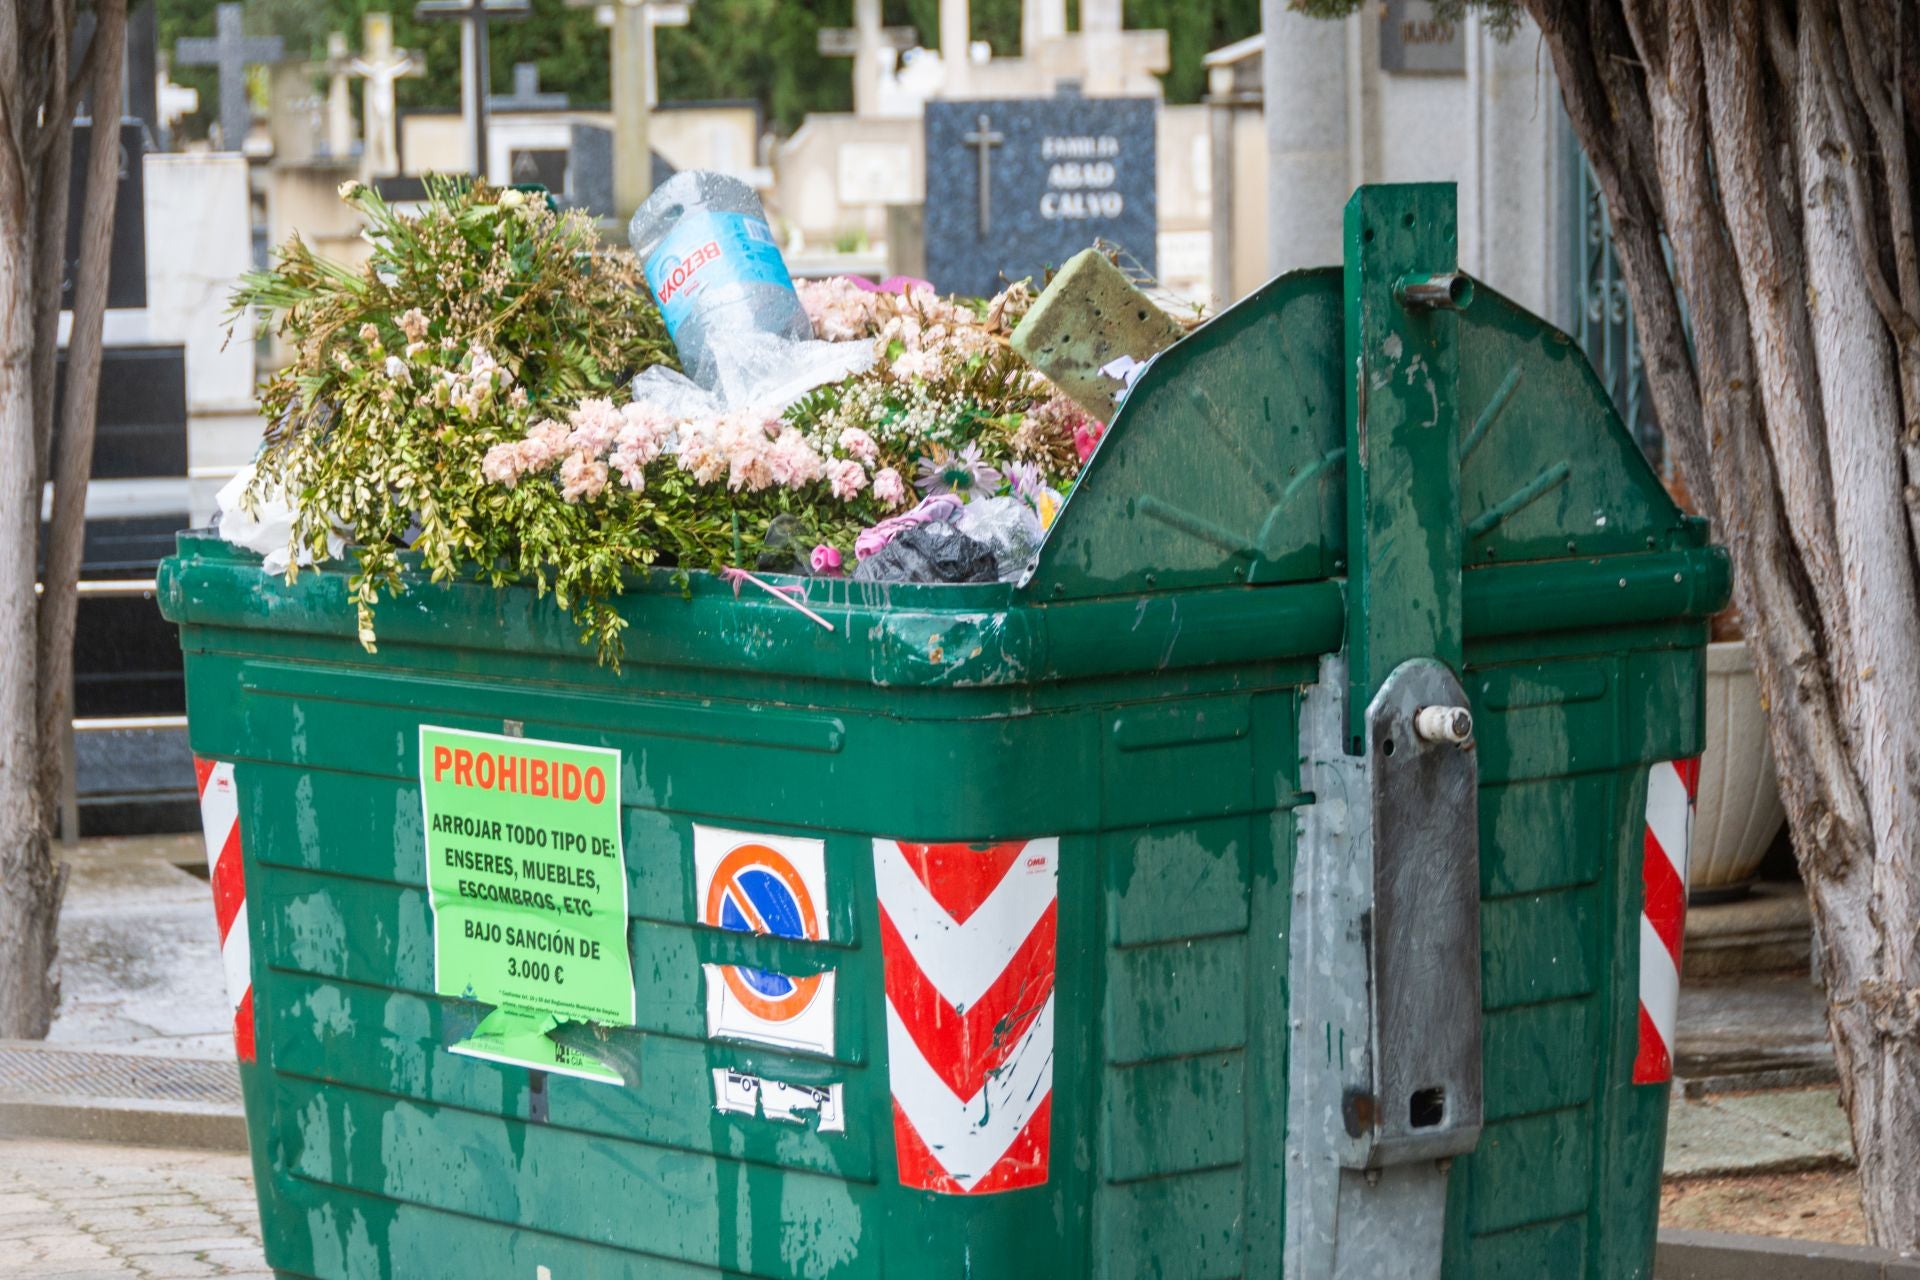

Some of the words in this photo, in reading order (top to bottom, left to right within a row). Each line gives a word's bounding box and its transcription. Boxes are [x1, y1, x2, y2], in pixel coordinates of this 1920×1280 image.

[1040, 192, 1123, 219] CALVO
[658, 241, 721, 304] BEZOYA
[434, 745, 606, 805] PROHIBIDO
[432, 813, 502, 841] ARROJAR
[506, 823, 547, 848] TODO
[551, 830, 587, 854] TIPO
[591, 836, 616, 858] DE:
[445, 847, 519, 880] ENSERES,
[522, 859, 600, 894] MUEBLES,
[458, 879, 562, 917] ESCOMBROS,
[563, 896, 593, 917] ETC
[465, 919, 502, 943] BAJO
[506, 927, 575, 956] SANCIÓN
[579, 939, 600, 960] DE
[508, 957, 550, 982] 3.000
[554, 965, 564, 985] €
